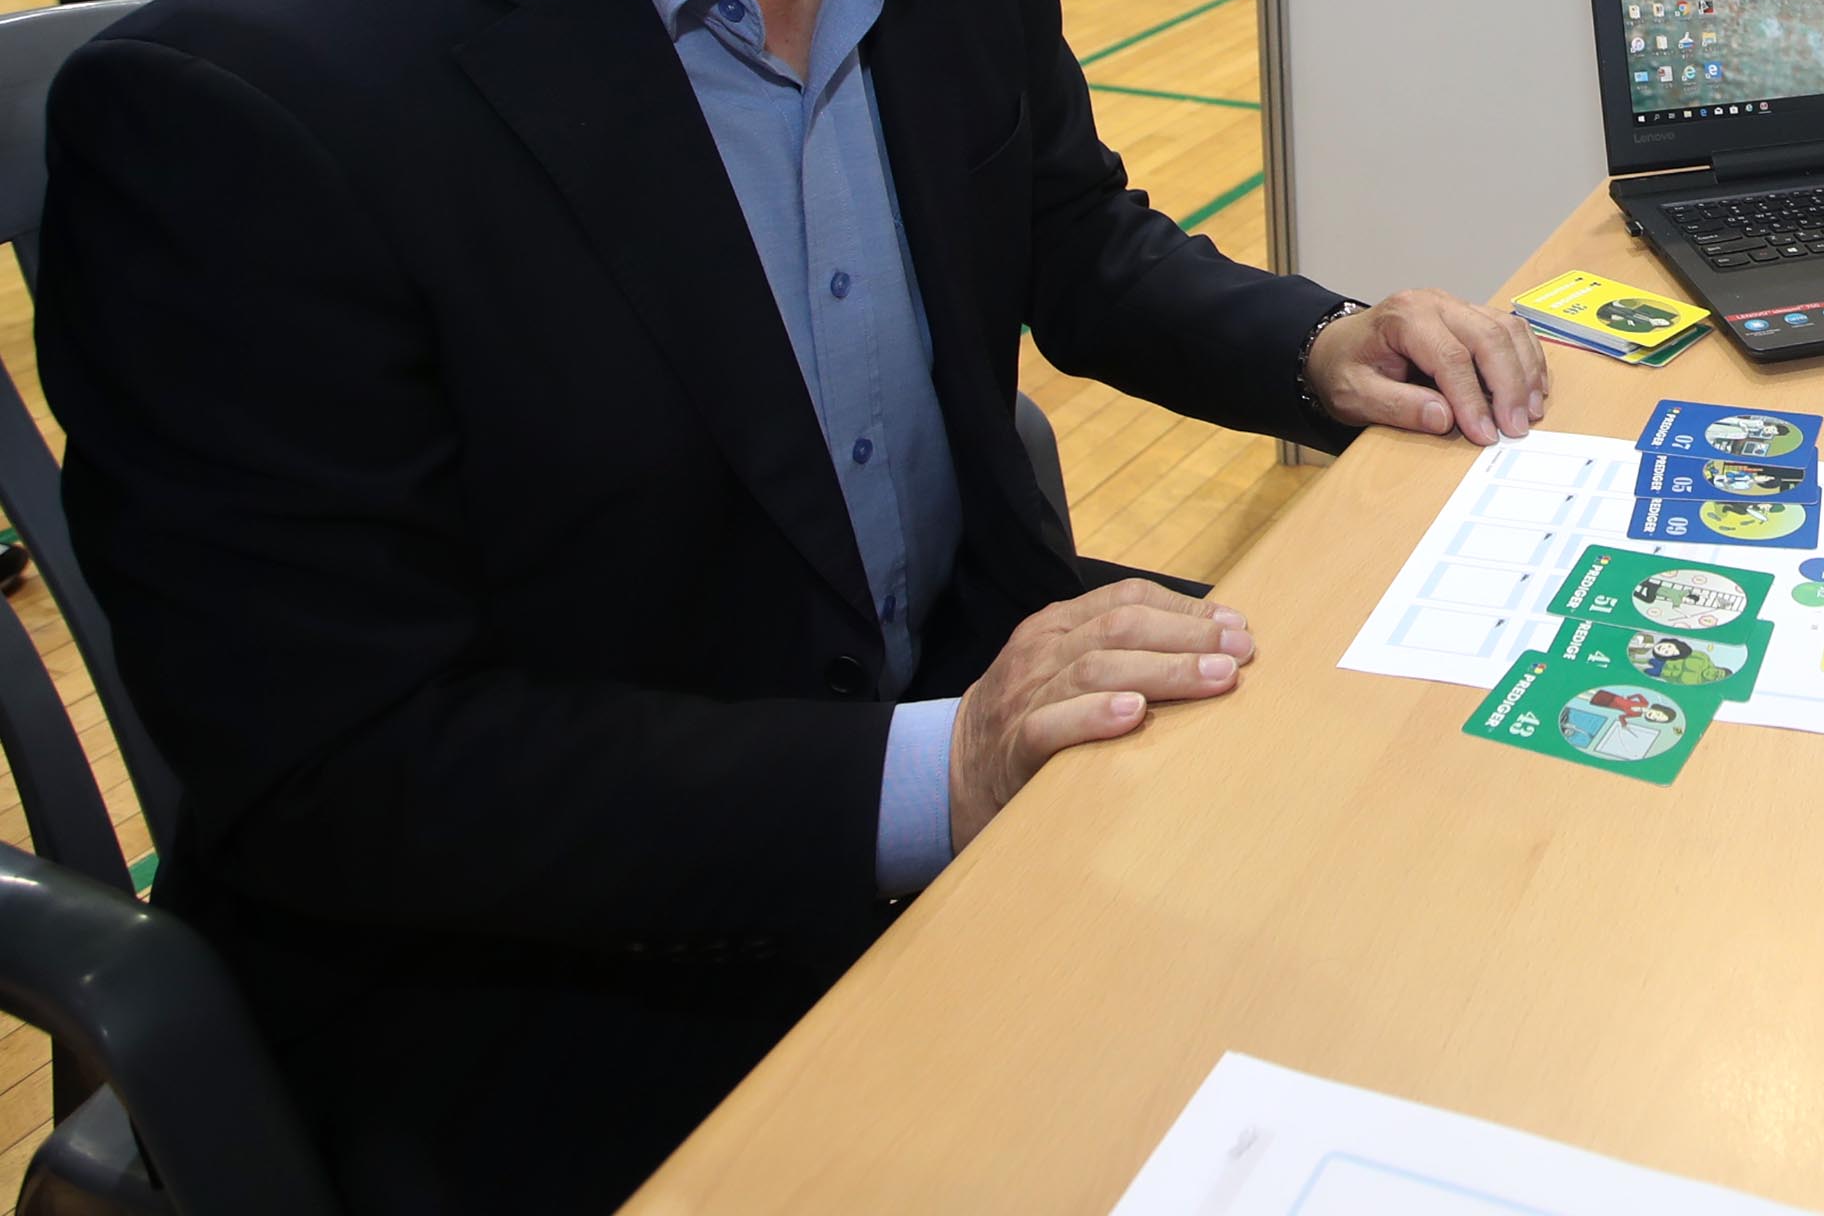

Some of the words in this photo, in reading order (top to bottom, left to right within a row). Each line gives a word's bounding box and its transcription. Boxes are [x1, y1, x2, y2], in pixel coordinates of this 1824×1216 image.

[1633, 131, 1675, 144] Lenovo
[1651, 413, 1677, 446] PREDIGER
[1671, 434, 1694, 450] 07
[1650, 455, 1668, 491] PREDIGER
[1672, 476, 1694, 493] 05
[1643, 498, 1662, 533] REDIGER
[1665, 517, 1689, 536] 09
[1566, 564, 1604, 608] PREDIGER
[1589, 594, 1619, 614] 51
[1563, 620, 1594, 661] PREDIGE
[1485, 673, 1537, 728] PREDIGER
[1509, 711, 1541, 738] 43
